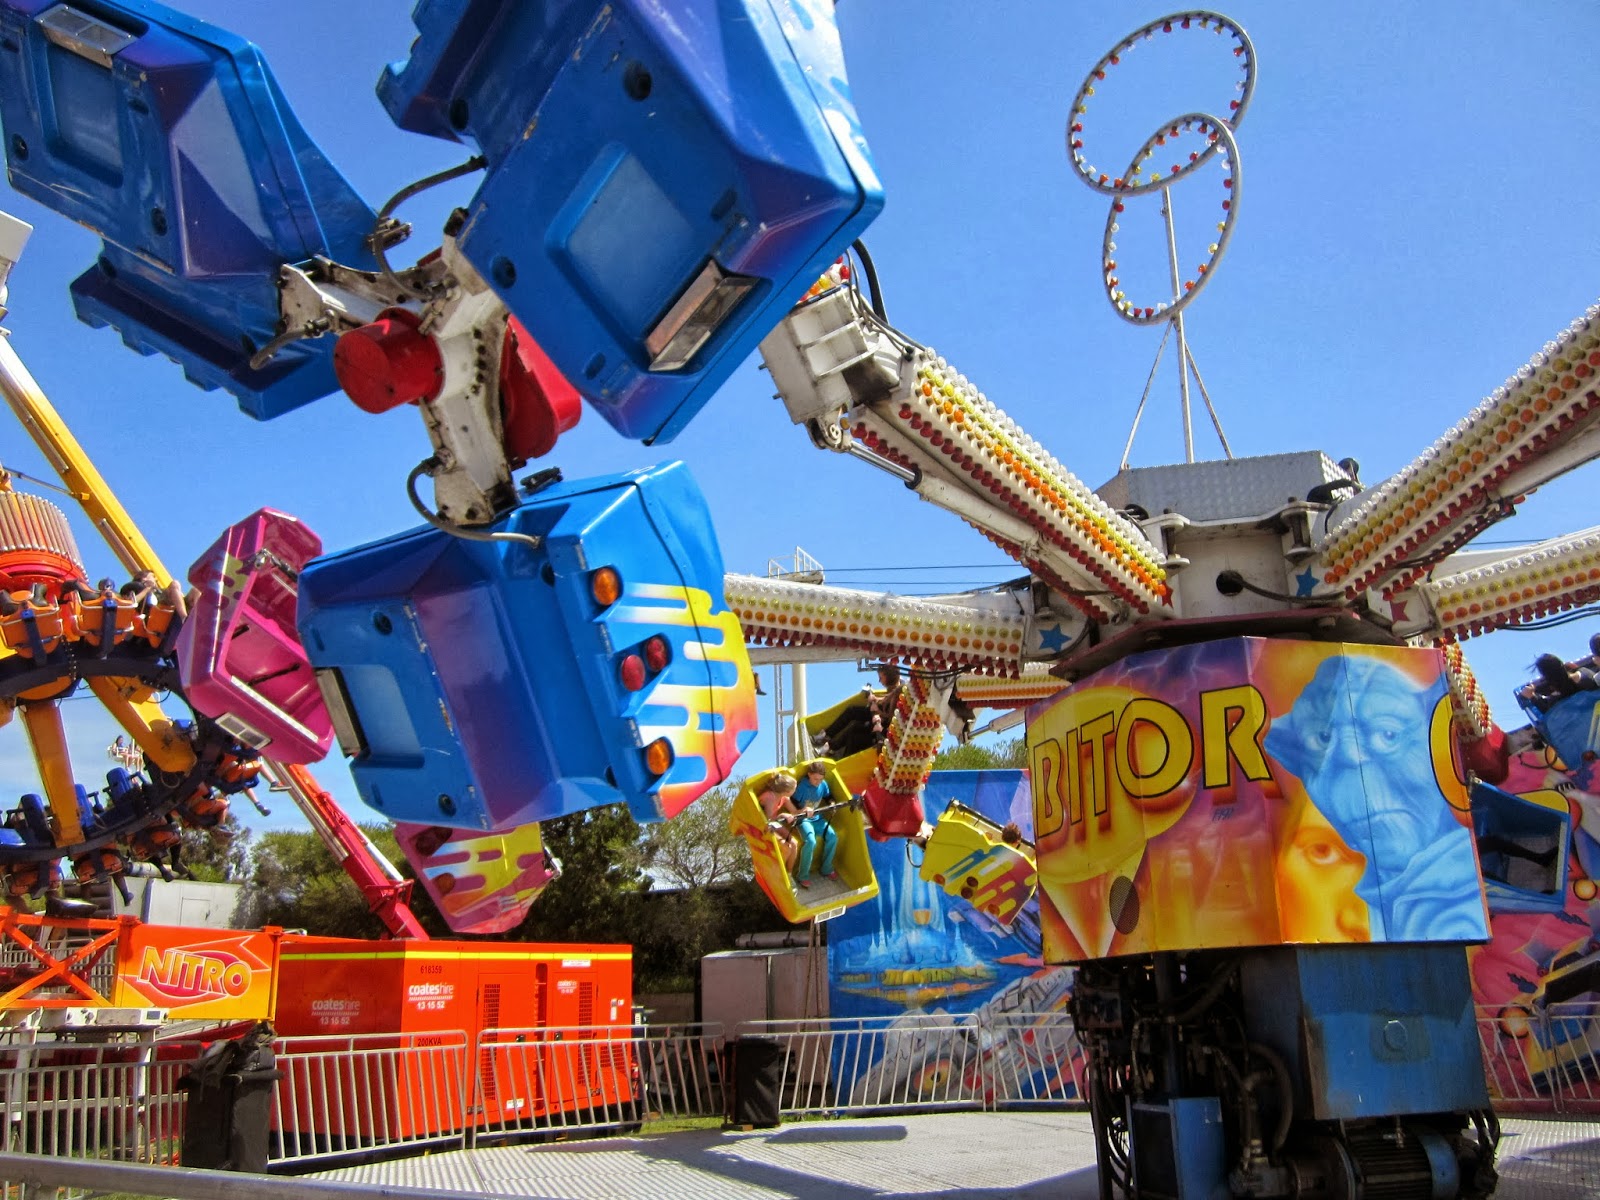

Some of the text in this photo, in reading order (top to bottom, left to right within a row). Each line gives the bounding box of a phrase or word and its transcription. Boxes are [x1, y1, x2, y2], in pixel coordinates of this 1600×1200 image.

[1033, 684, 1273, 839] BITOR
[137, 946, 252, 997] NITRO
[420, 965, 442, 974] 618359
[417, 1001, 425, 1010] 13
[436, 1000, 445, 1009] 52
